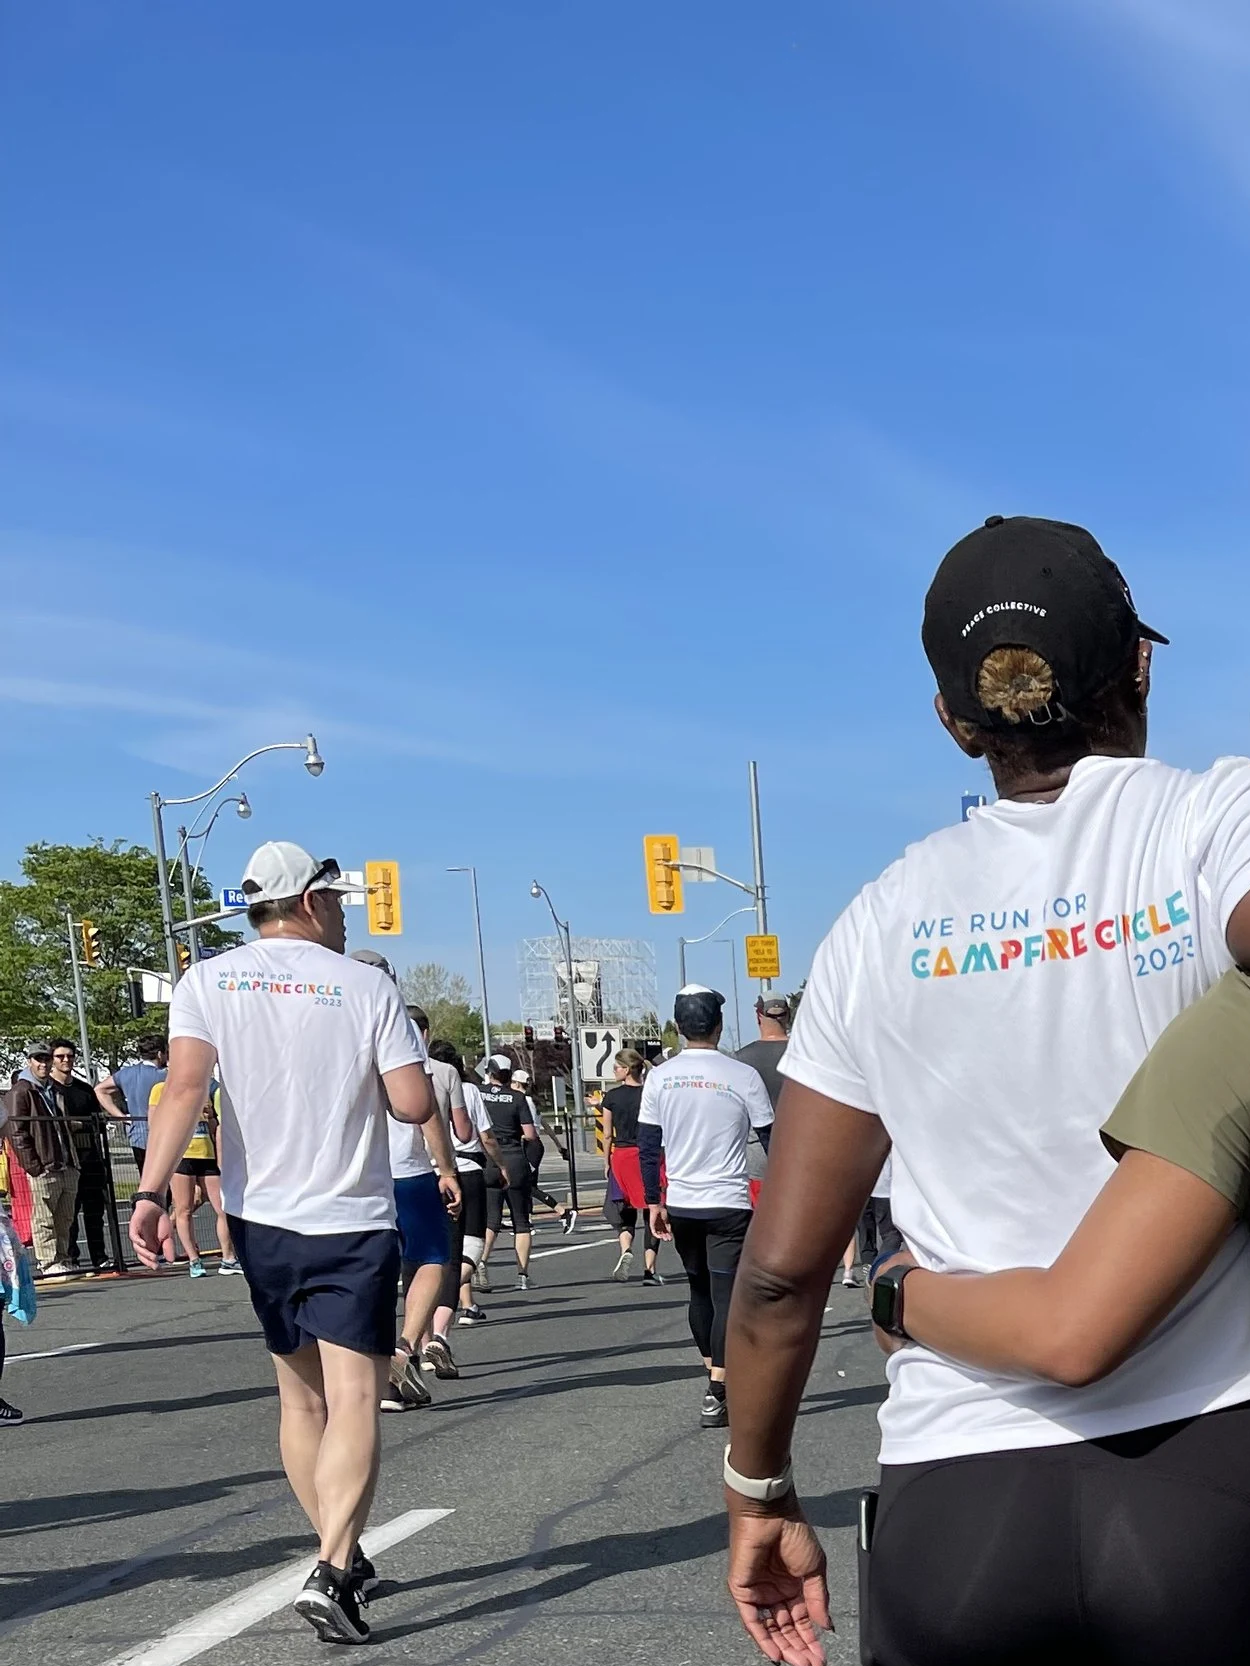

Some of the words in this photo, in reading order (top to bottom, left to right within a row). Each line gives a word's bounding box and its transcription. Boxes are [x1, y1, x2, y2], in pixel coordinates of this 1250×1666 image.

[986, 601, 1047, 617] COLLECTIVE
[228, 890, 245, 903] Re
[912, 917, 953, 939] WE
[970, 908, 1029, 930] RUN
[911, 922, 1088, 980] CAMPFIRE
[241, 971, 265, 979] RUN
[270, 973, 293, 981] FOR
[217, 980, 291, 994] CAMPFIRE
[294, 983, 342, 997] CIRCLE
[314, 997, 342, 1007] 2023
